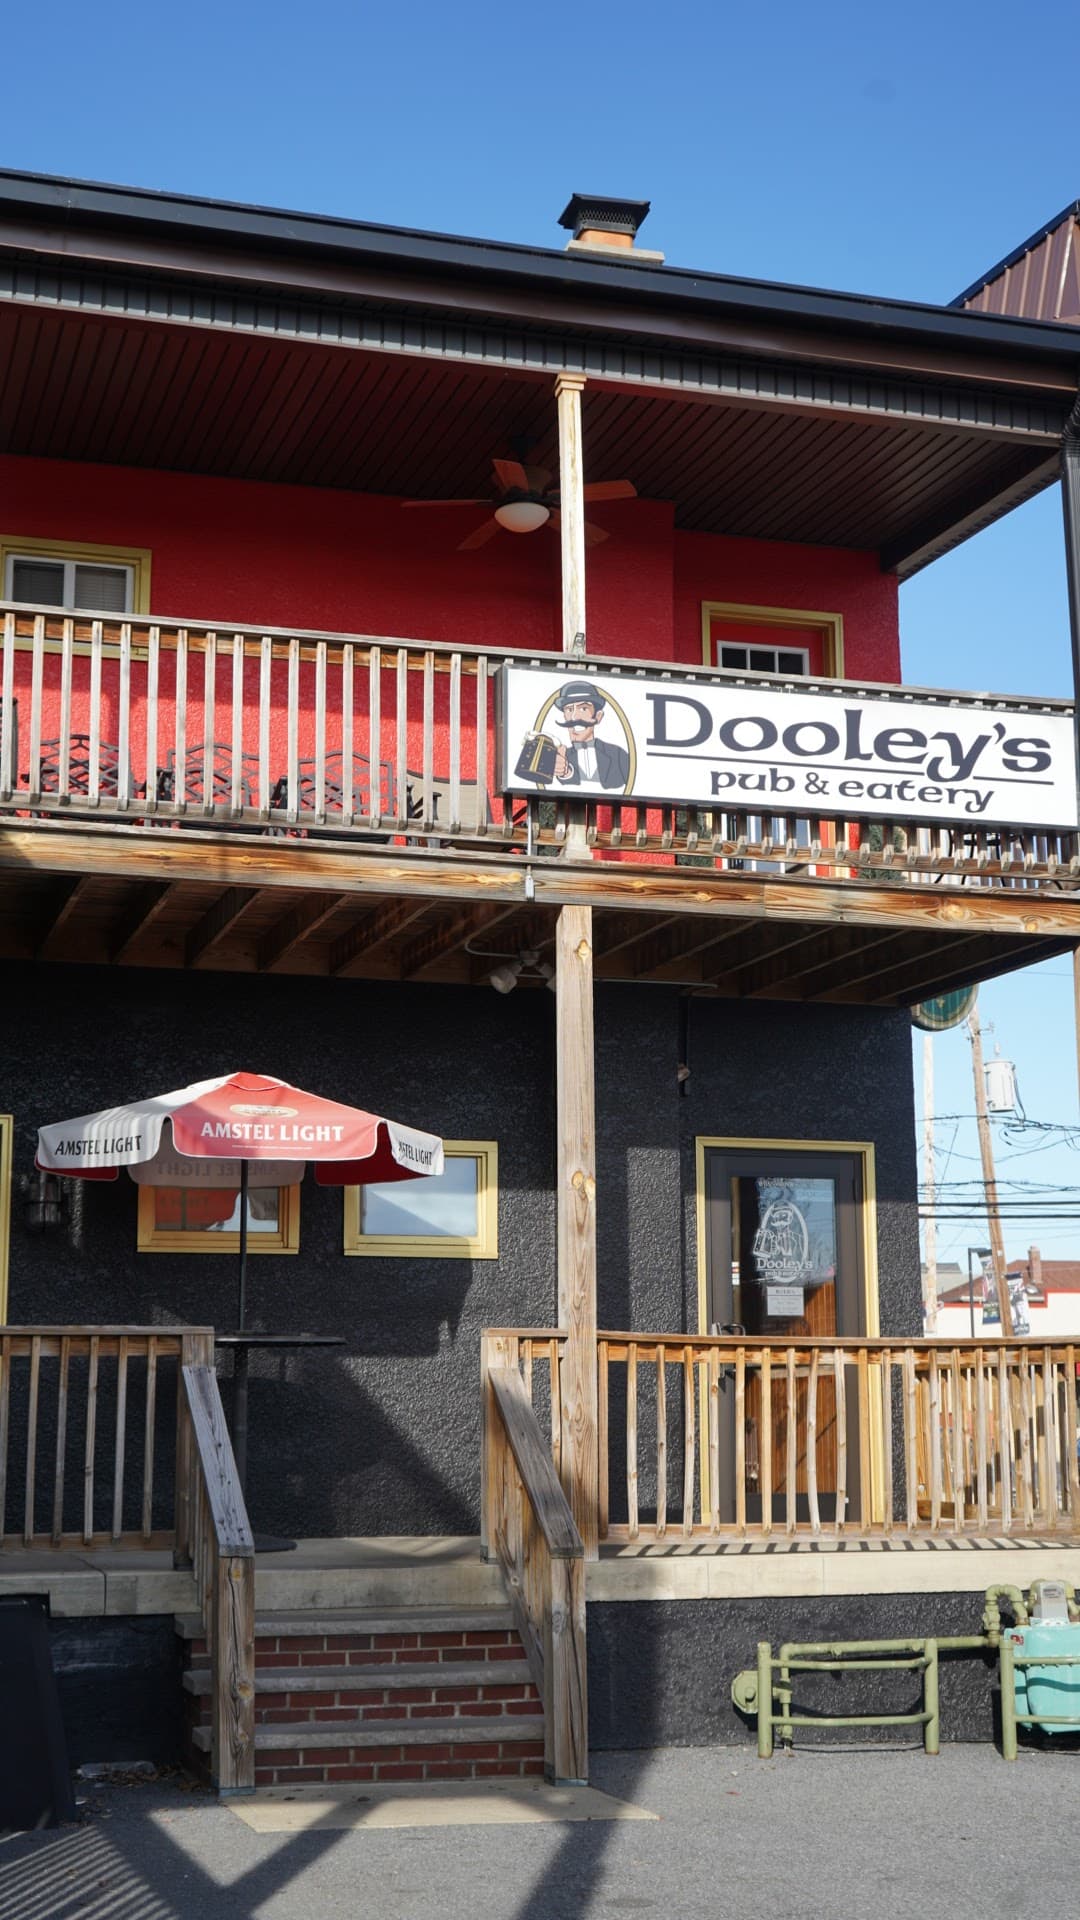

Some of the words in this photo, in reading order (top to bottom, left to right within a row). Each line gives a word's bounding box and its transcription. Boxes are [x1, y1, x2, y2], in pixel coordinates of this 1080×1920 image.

[646, 693, 1053, 781] Dooley's
[710, 768, 796, 795] pub
[805, 772, 830, 796] &
[839, 779, 995, 813] eatery
[201, 1122, 274, 1140] AMSTEL
[280, 1124, 345, 1142] LIGHT
[55, 1140, 100, 1156] AMSTEL
[104, 1135, 142, 1154] LIGHT
[415, 1148, 433, 1166] LIGHT
